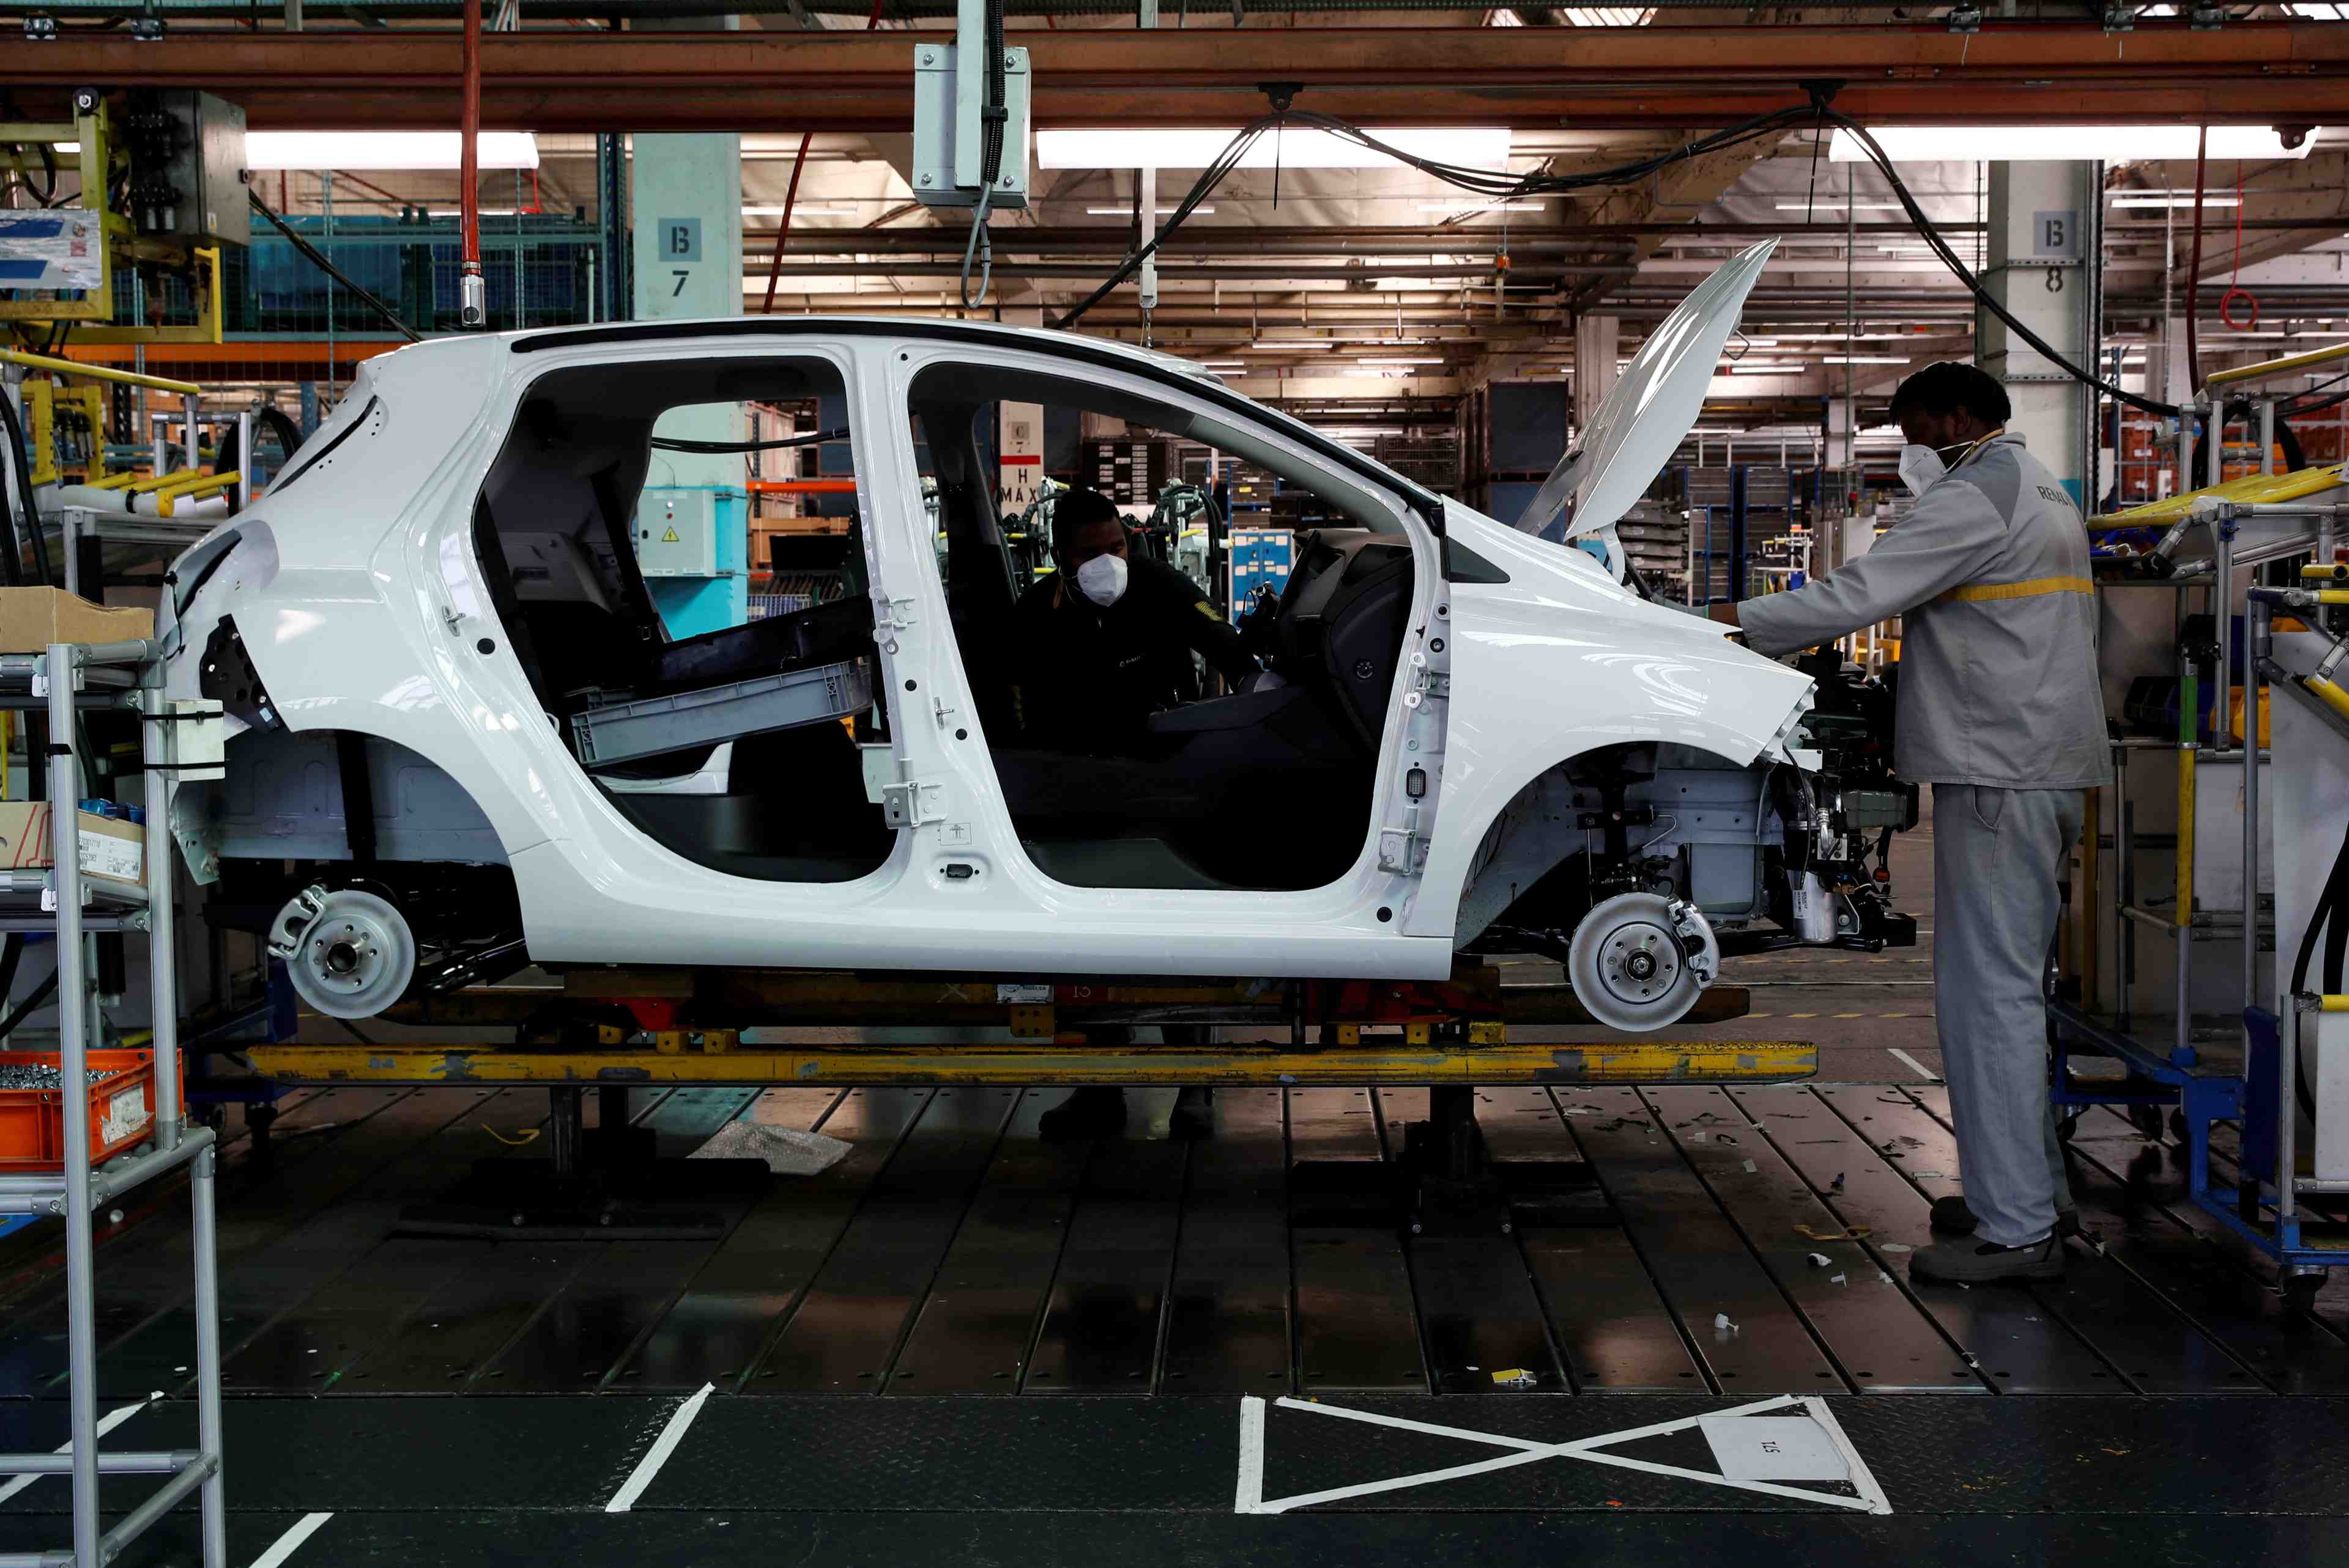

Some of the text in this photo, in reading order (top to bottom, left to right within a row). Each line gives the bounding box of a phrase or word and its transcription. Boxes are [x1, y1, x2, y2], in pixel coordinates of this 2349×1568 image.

[671, 226, 690, 254] B
[2046, 220, 2063, 246] B
[672, 270, 689, 297] 7
[2046, 265, 2063, 292] 8
[1018, 468, 1028, 484] H
[1001, 487, 1038, 503] MAX
[1761, 1441, 1781, 1453] 571
